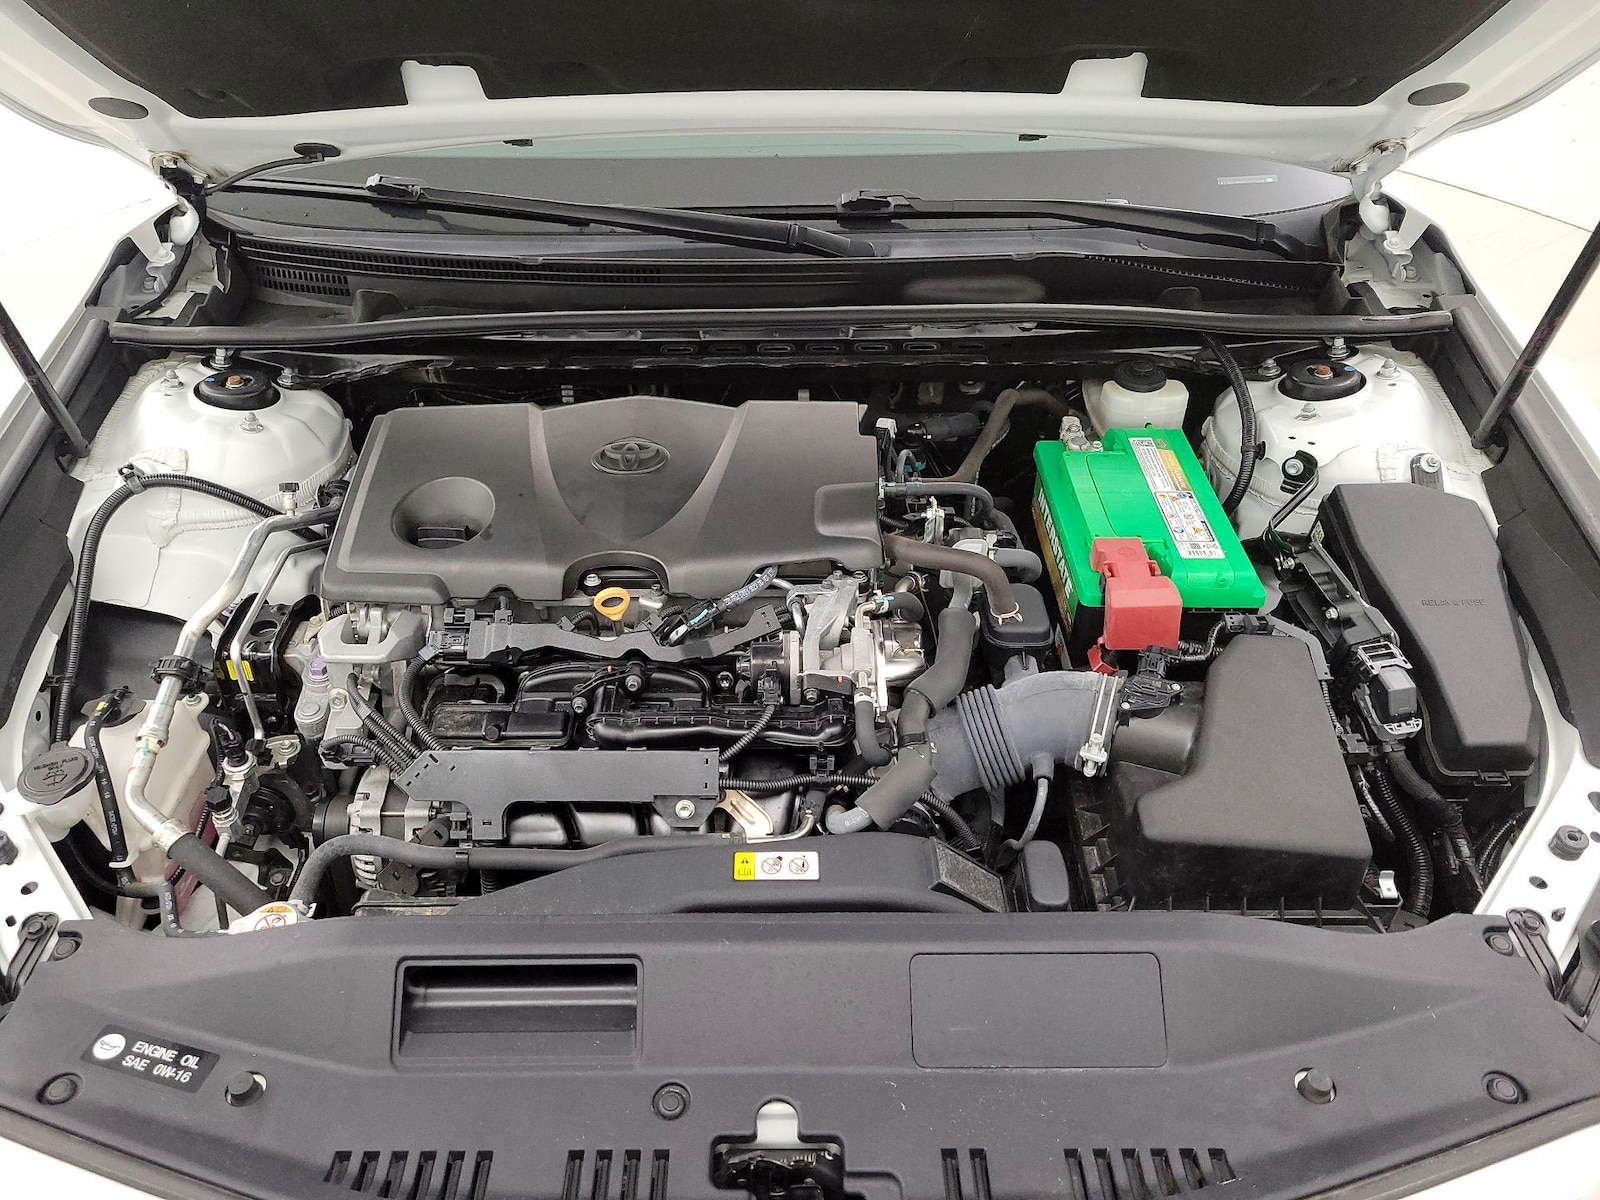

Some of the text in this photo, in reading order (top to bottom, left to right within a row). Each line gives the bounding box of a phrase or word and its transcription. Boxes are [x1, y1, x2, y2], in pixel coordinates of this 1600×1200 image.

[1038, 487, 1073, 599] INTERSTATE
[121, 1054, 193, 1083] SAE 0W-16
[131, 1040, 201, 1069] ENGINE OIL
